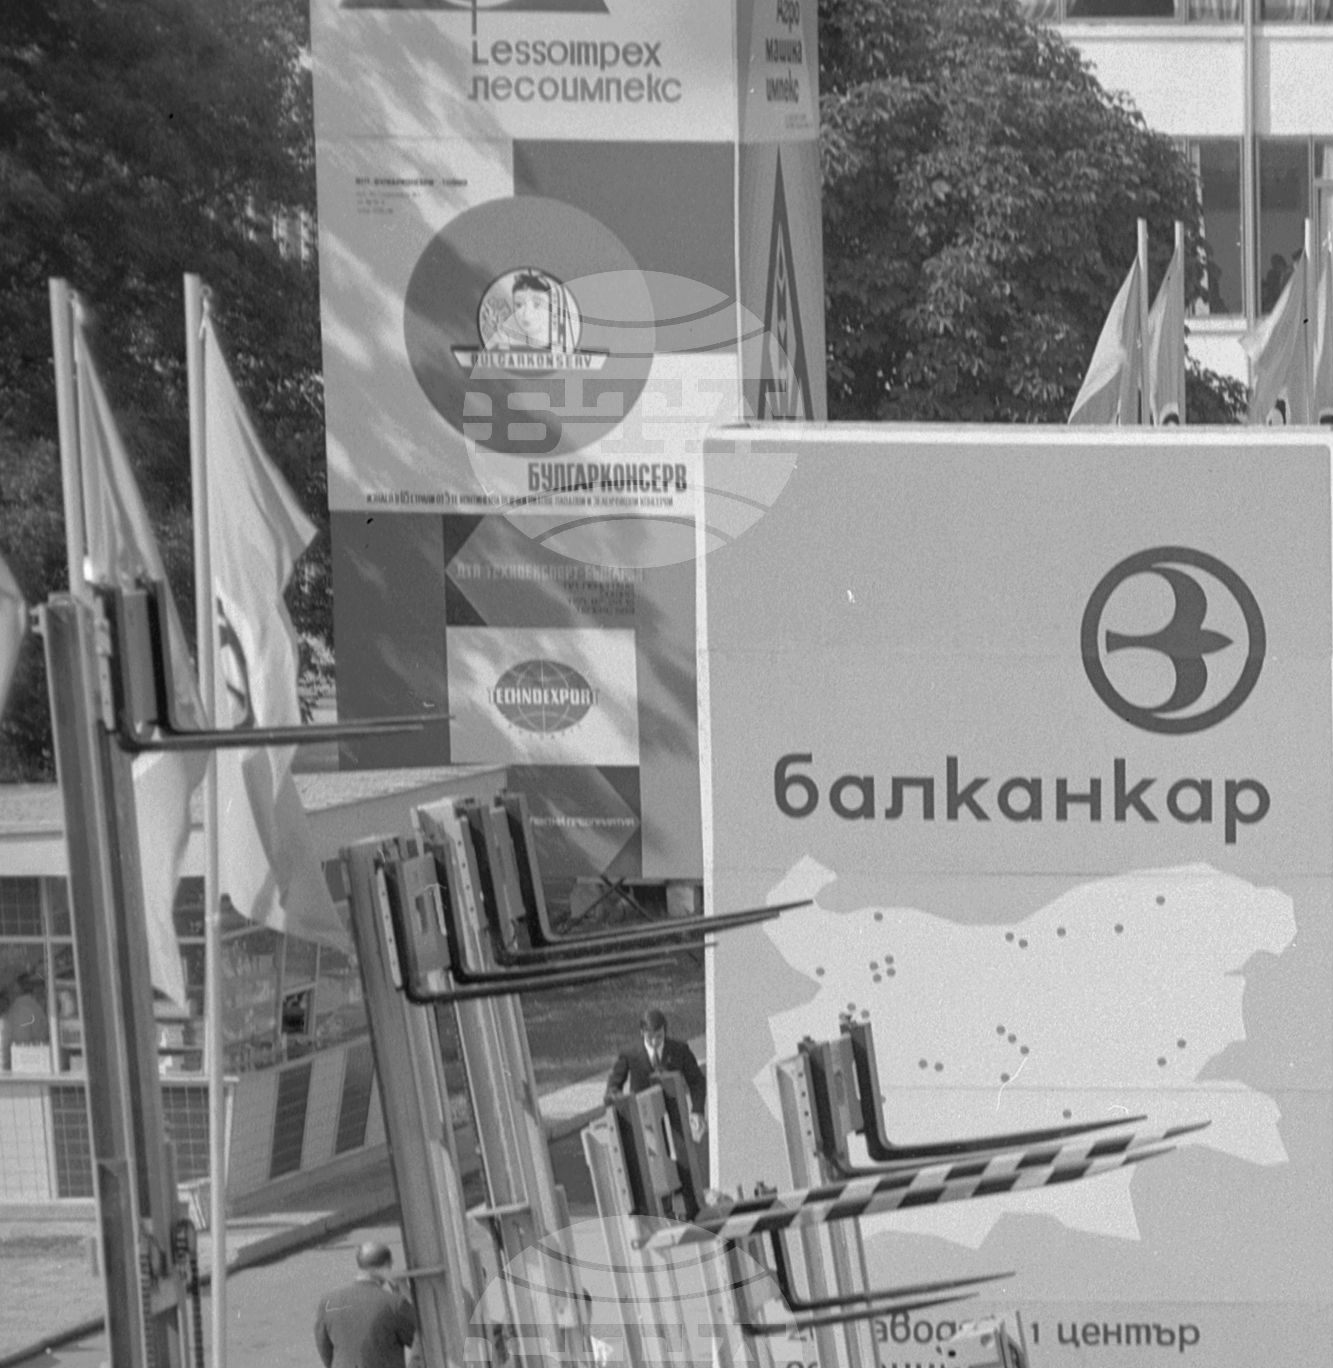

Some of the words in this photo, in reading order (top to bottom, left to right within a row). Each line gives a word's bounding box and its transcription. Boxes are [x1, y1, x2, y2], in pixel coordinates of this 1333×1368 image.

[472, 39, 662, 69] Lessoimpex
[528, 462, 687, 493] БУЛГАРКОНСЕРВ
[773, 752, 1271, 844] балканкар
[1057, 1321, 1201, 1353] център
